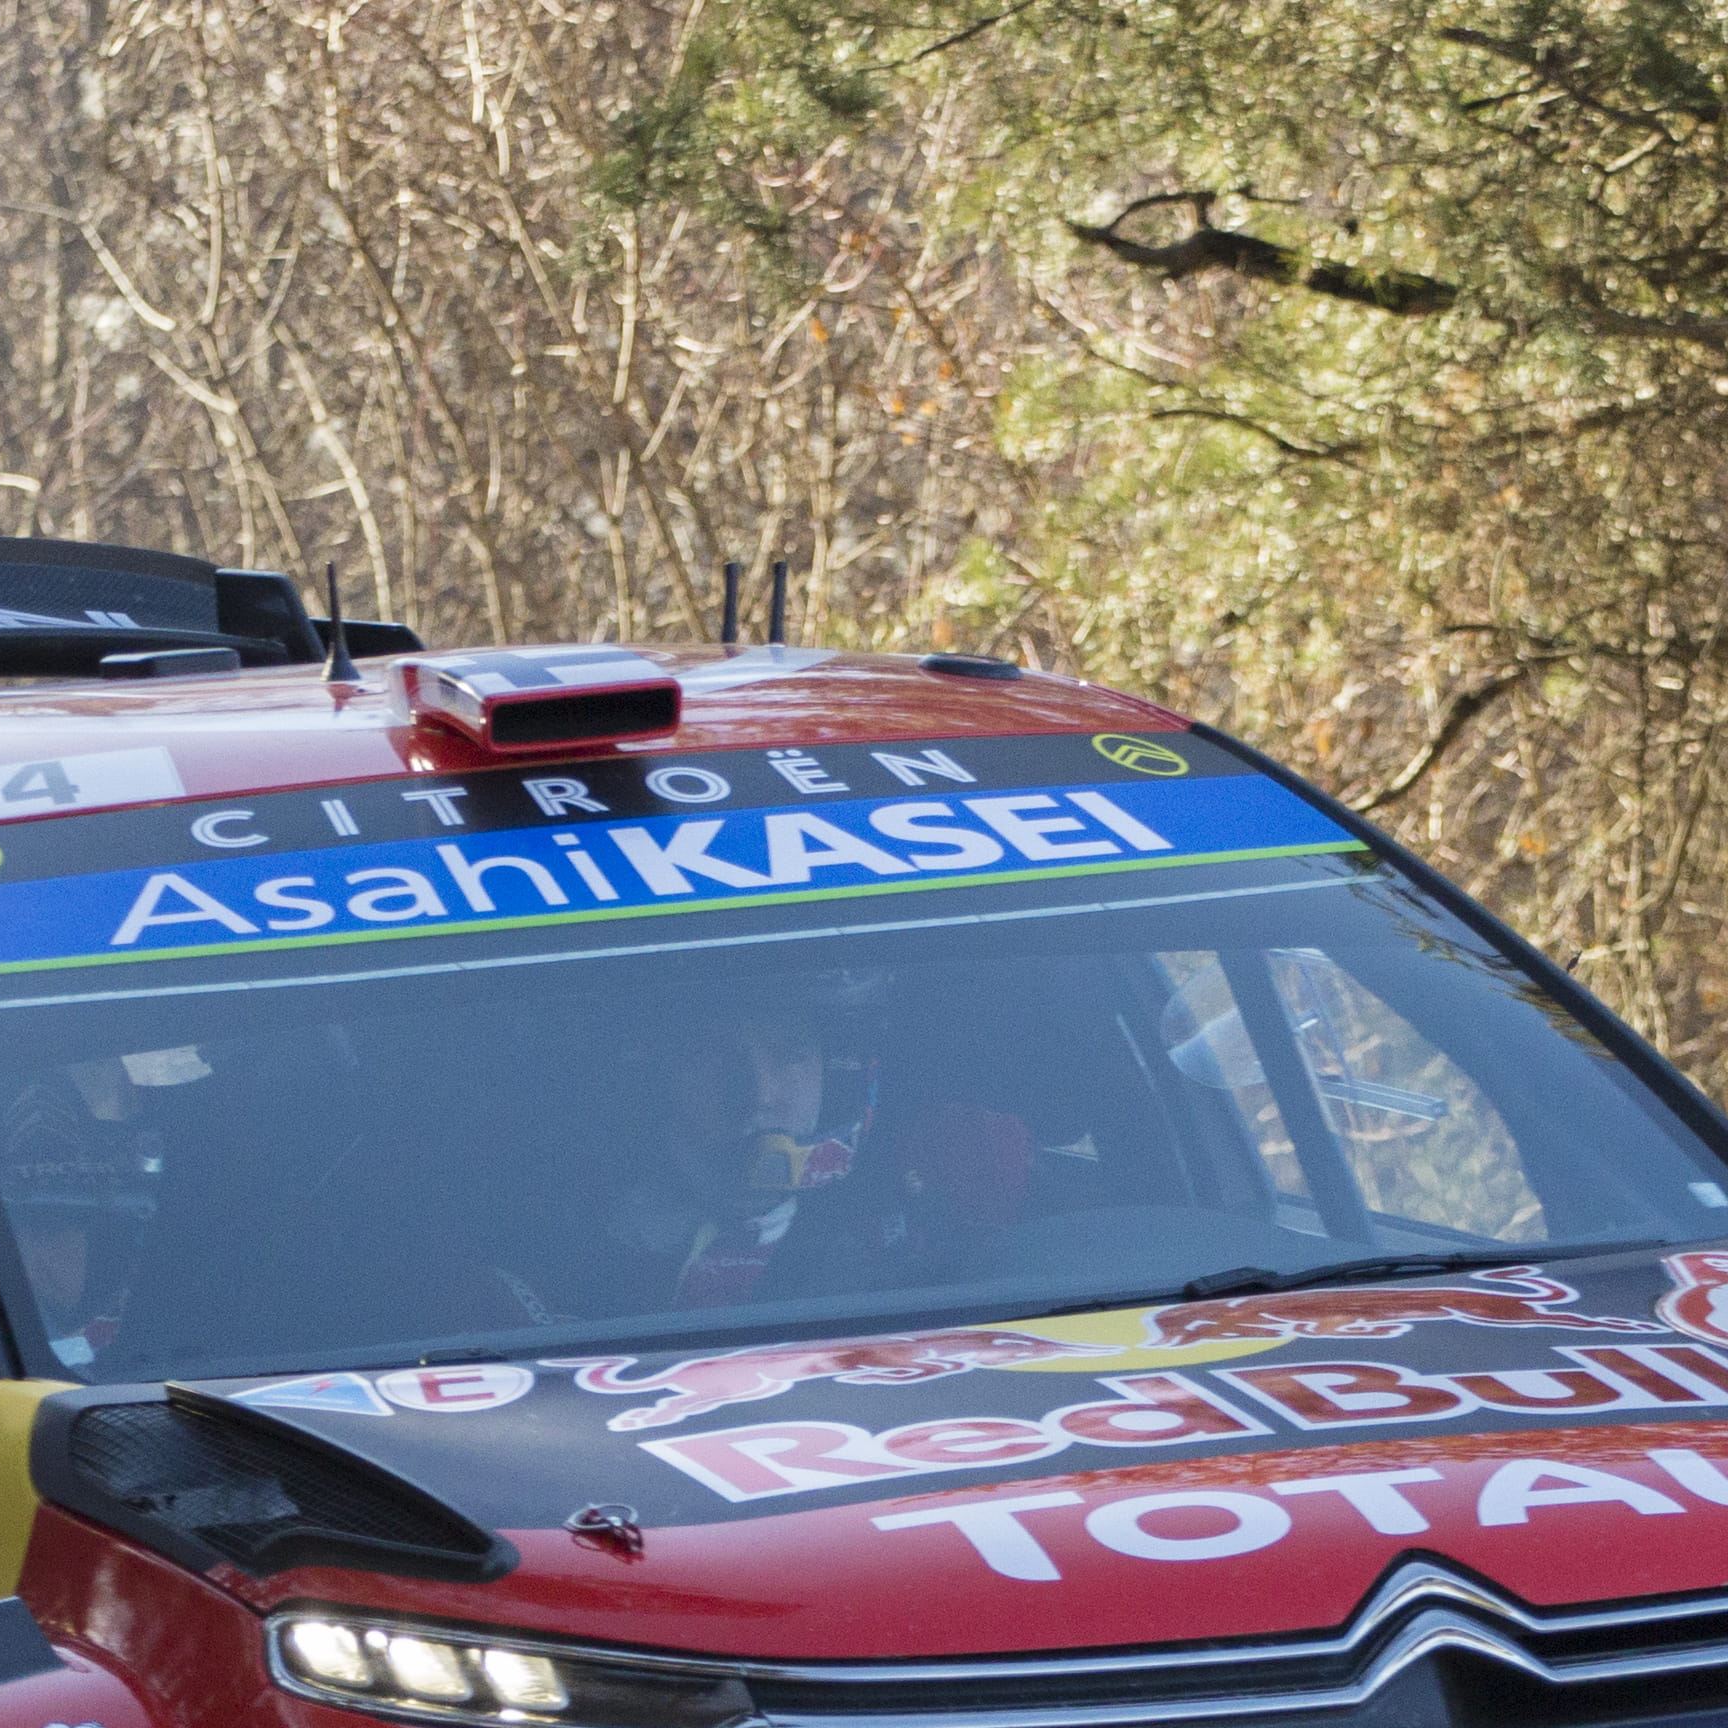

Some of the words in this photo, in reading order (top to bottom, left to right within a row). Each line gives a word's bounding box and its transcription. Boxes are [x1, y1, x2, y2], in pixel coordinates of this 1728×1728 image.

[1, 760, 81, 805] 4
[191, 747, 978, 850] CITROËN
[110, 791, 1175, 946] AsahiKASEI
[415, 1370, 495, 1404] E
[637, 1370, 1277, 1503] Red
